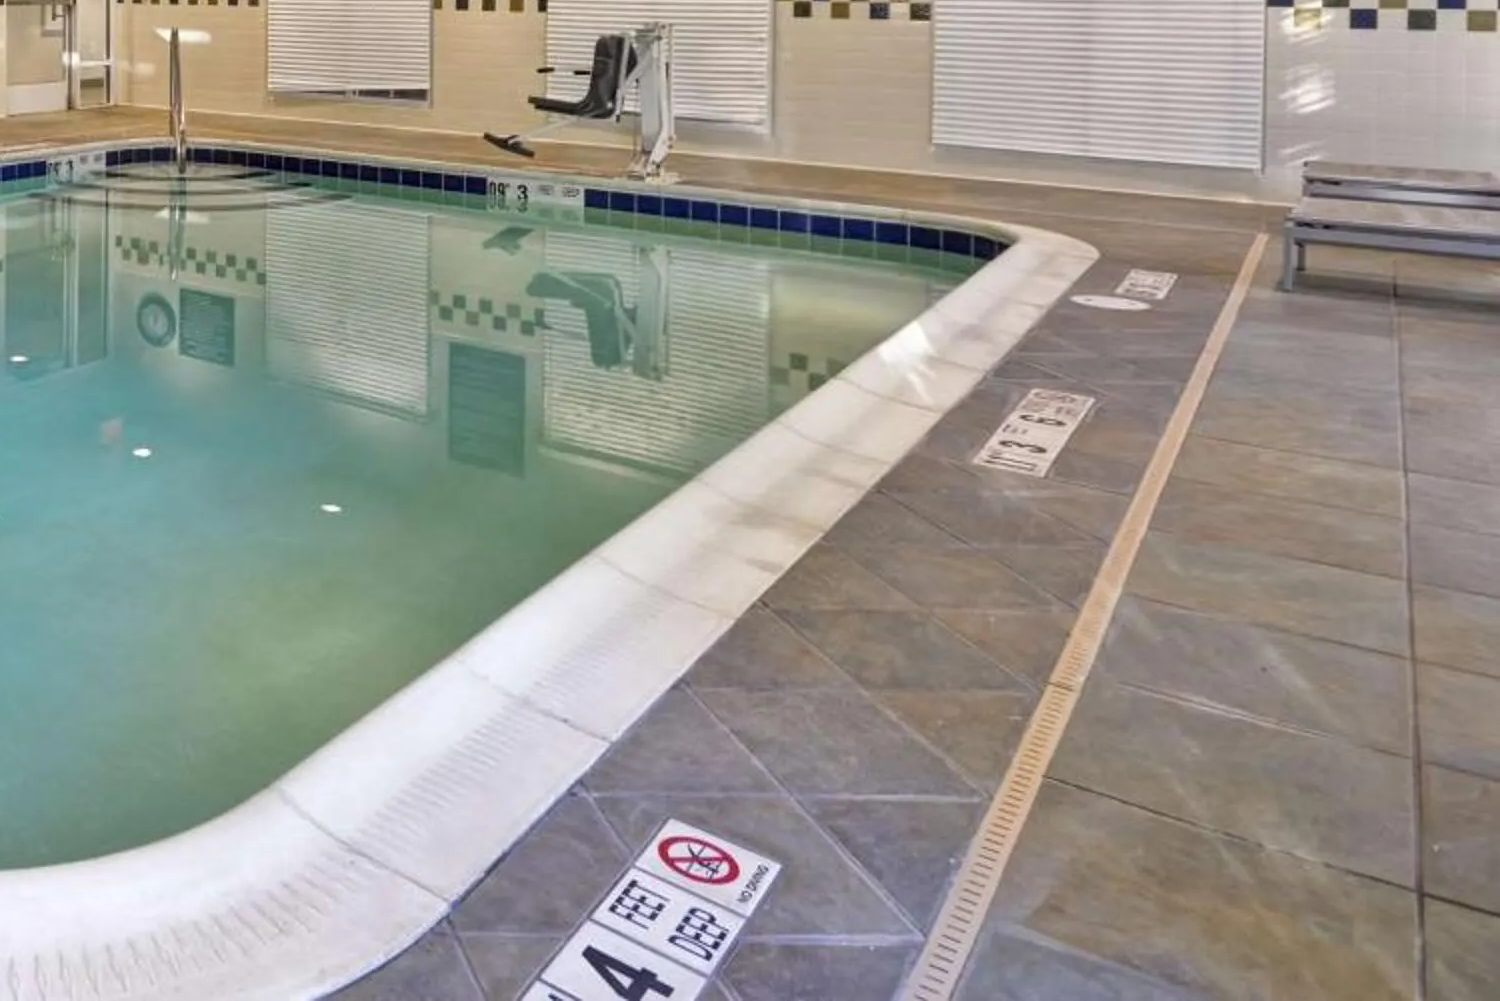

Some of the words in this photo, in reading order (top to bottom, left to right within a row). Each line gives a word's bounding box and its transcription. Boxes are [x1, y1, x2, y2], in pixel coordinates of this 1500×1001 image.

[516, 185, 529, 200] 3
[608, 879, 670, 930] FEET
[667, 907, 730, 962] DEEP
[581, 945, 675, 1001] 4
